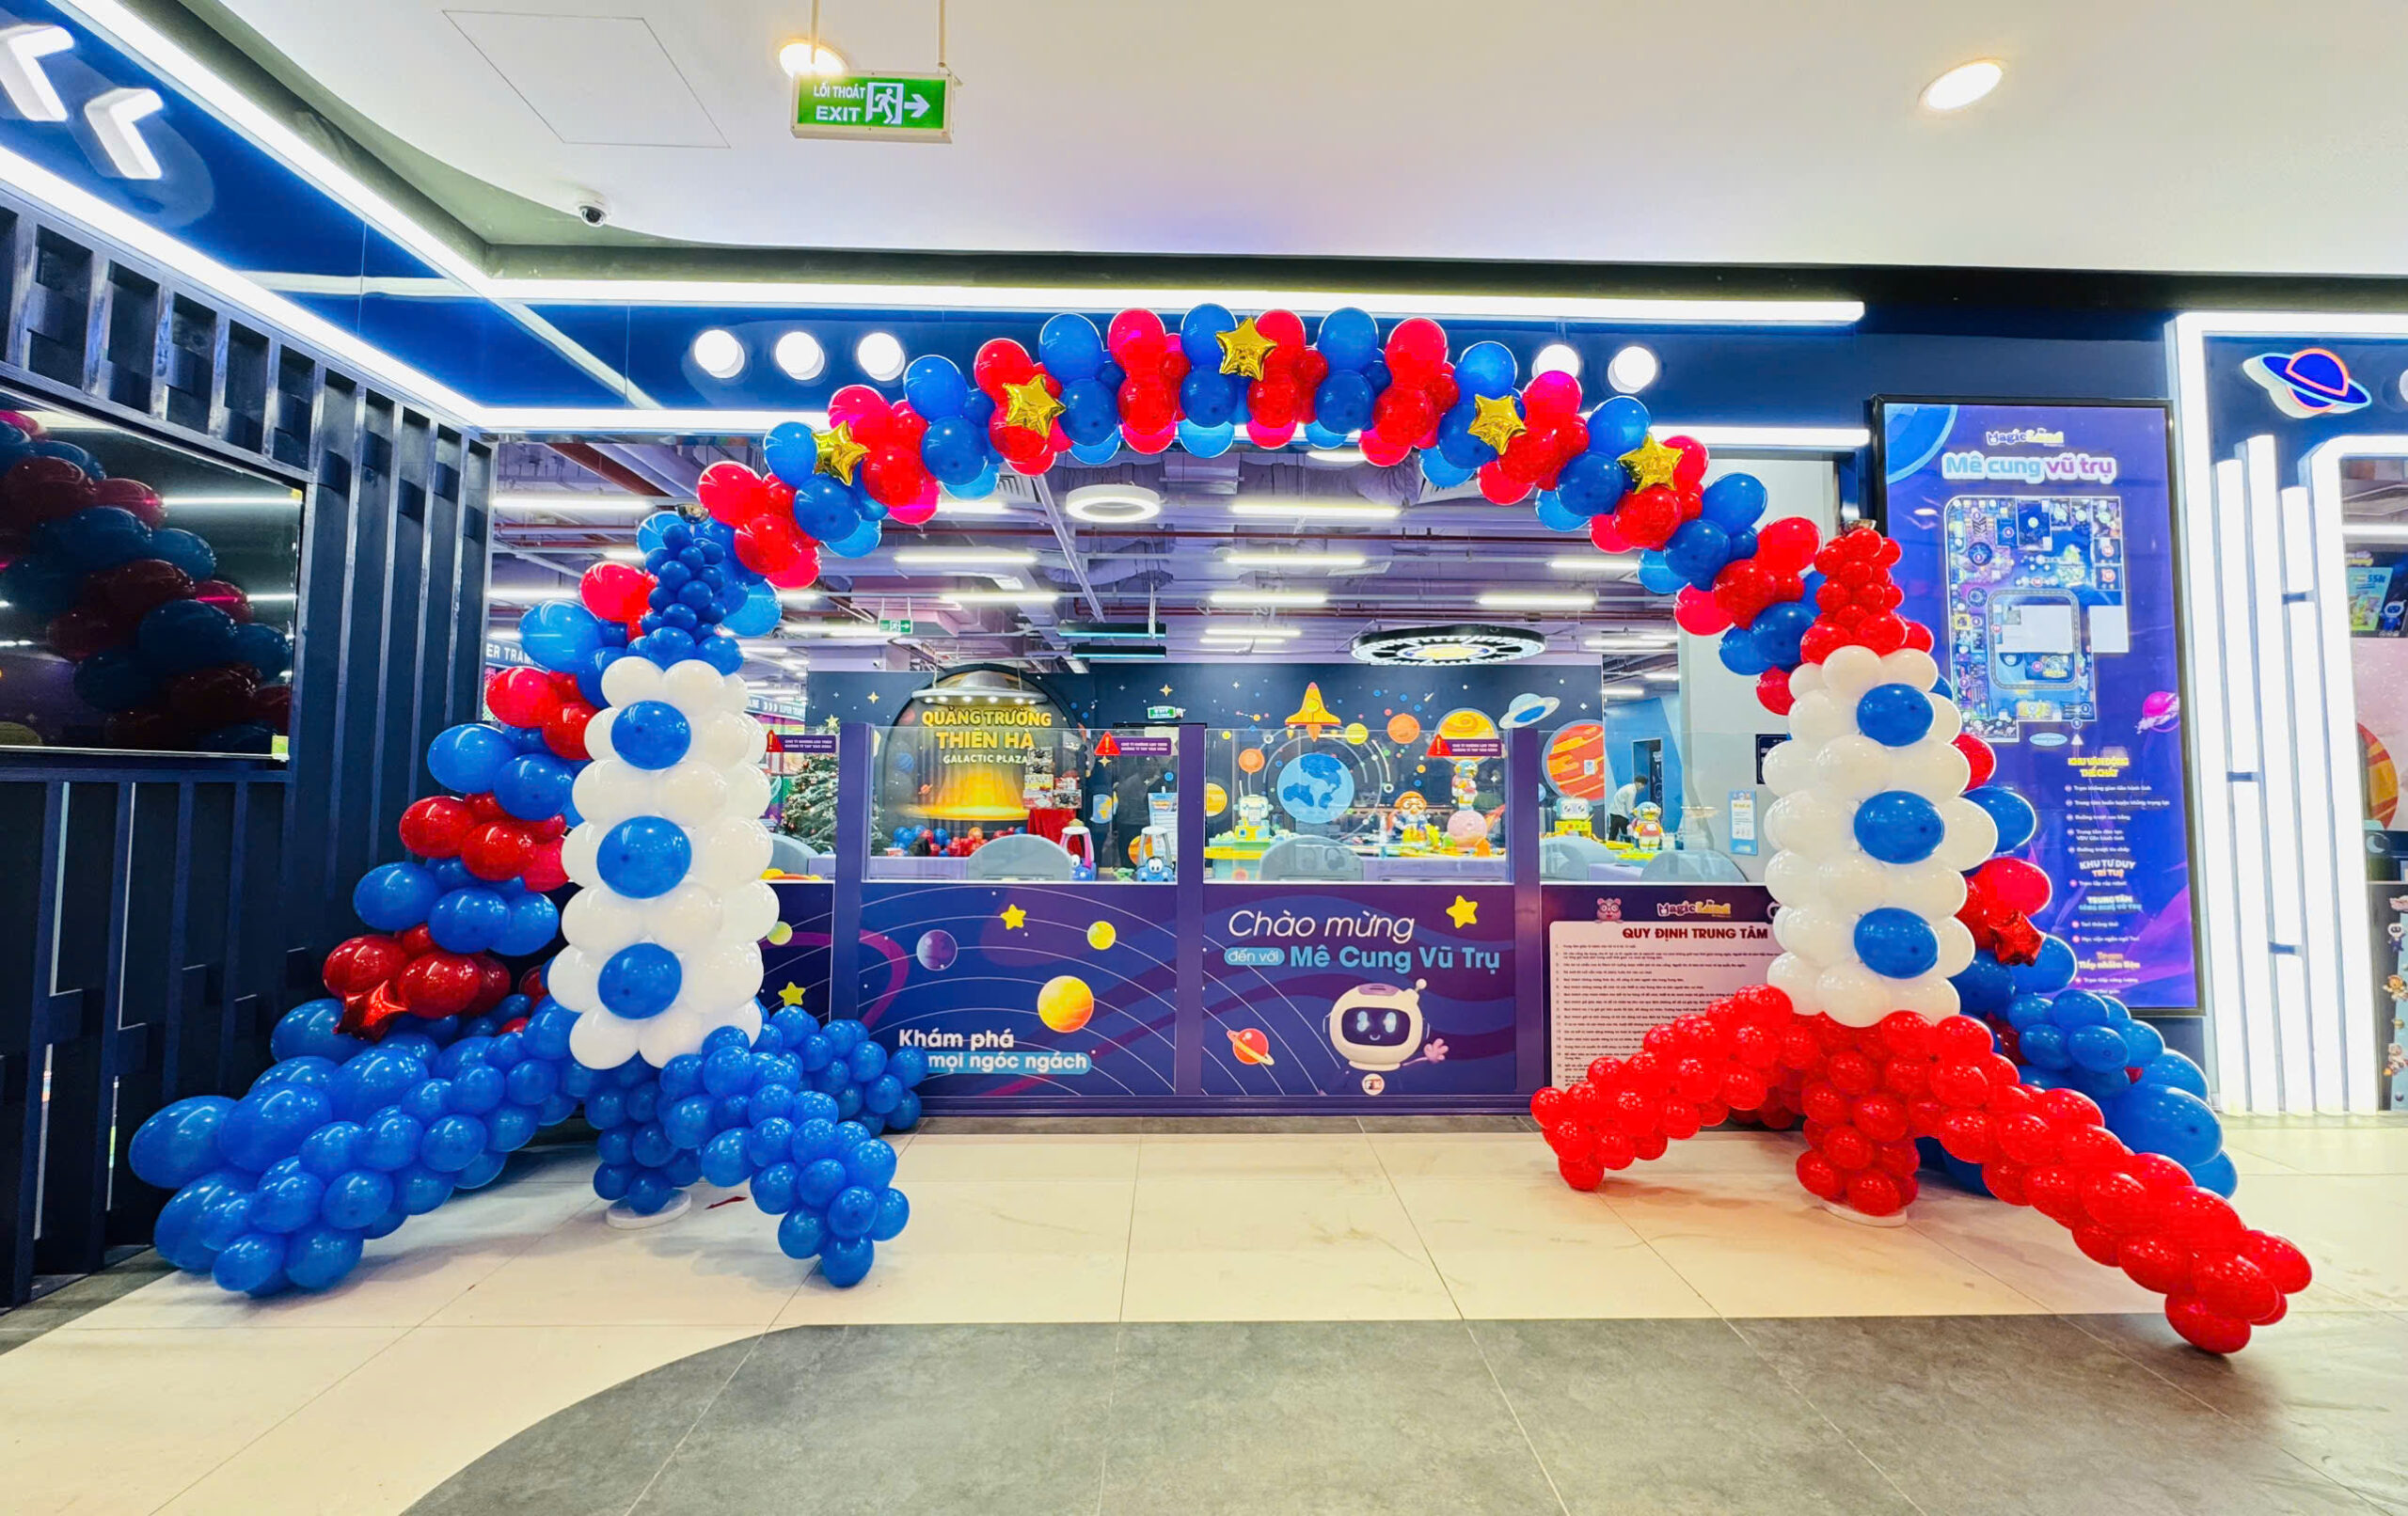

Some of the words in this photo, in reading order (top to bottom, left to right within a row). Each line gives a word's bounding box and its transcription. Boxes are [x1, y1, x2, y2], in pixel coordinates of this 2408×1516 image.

[813, 81, 831, 98] LỐI
[832, 83, 865, 99] THOÁT
[816, 105, 861, 122] EXIT
[1945, 453, 1983, 474] Mê
[1987, 459, 2042, 478] cung
[2045, 456, 2075, 474] vũ
[2079, 457, 2114, 478] trụ
[922, 705, 981, 727] QUẢNG
[985, 708, 1053, 727] TRƯỜNG
[936, 729, 998, 750] THIÊN
[1004, 729, 1035, 750] HÀ
[943, 754, 993, 765] GALACTIC
[996, 754, 1028, 764] PLAZA
[1228, 909, 1316, 938] Chào
[1323, 909, 1415, 944] mừng
[1623, 927, 1651, 939] QUY
[1655, 927, 1688, 941] ĐỊNH
[1692, 928, 1736, 939] TRUNG
[1739, 925, 1768, 939] TÂM
[1228, 948, 1257, 964] đến
[1259, 950, 1280, 964] với
[1291, 944, 1331, 969] Mê
[1339, 945, 1411, 974] Cung
[1418, 945, 1453, 969] Vũ
[1462, 946, 1500, 974] Trụ
[898, 1028, 963, 1049] Khám
[970, 1027, 1015, 1051] phá
[928, 1053, 963, 1073] mọi
[969, 1052, 1019, 1073] ngóc
[1024, 1051, 1087, 1073] ngách
